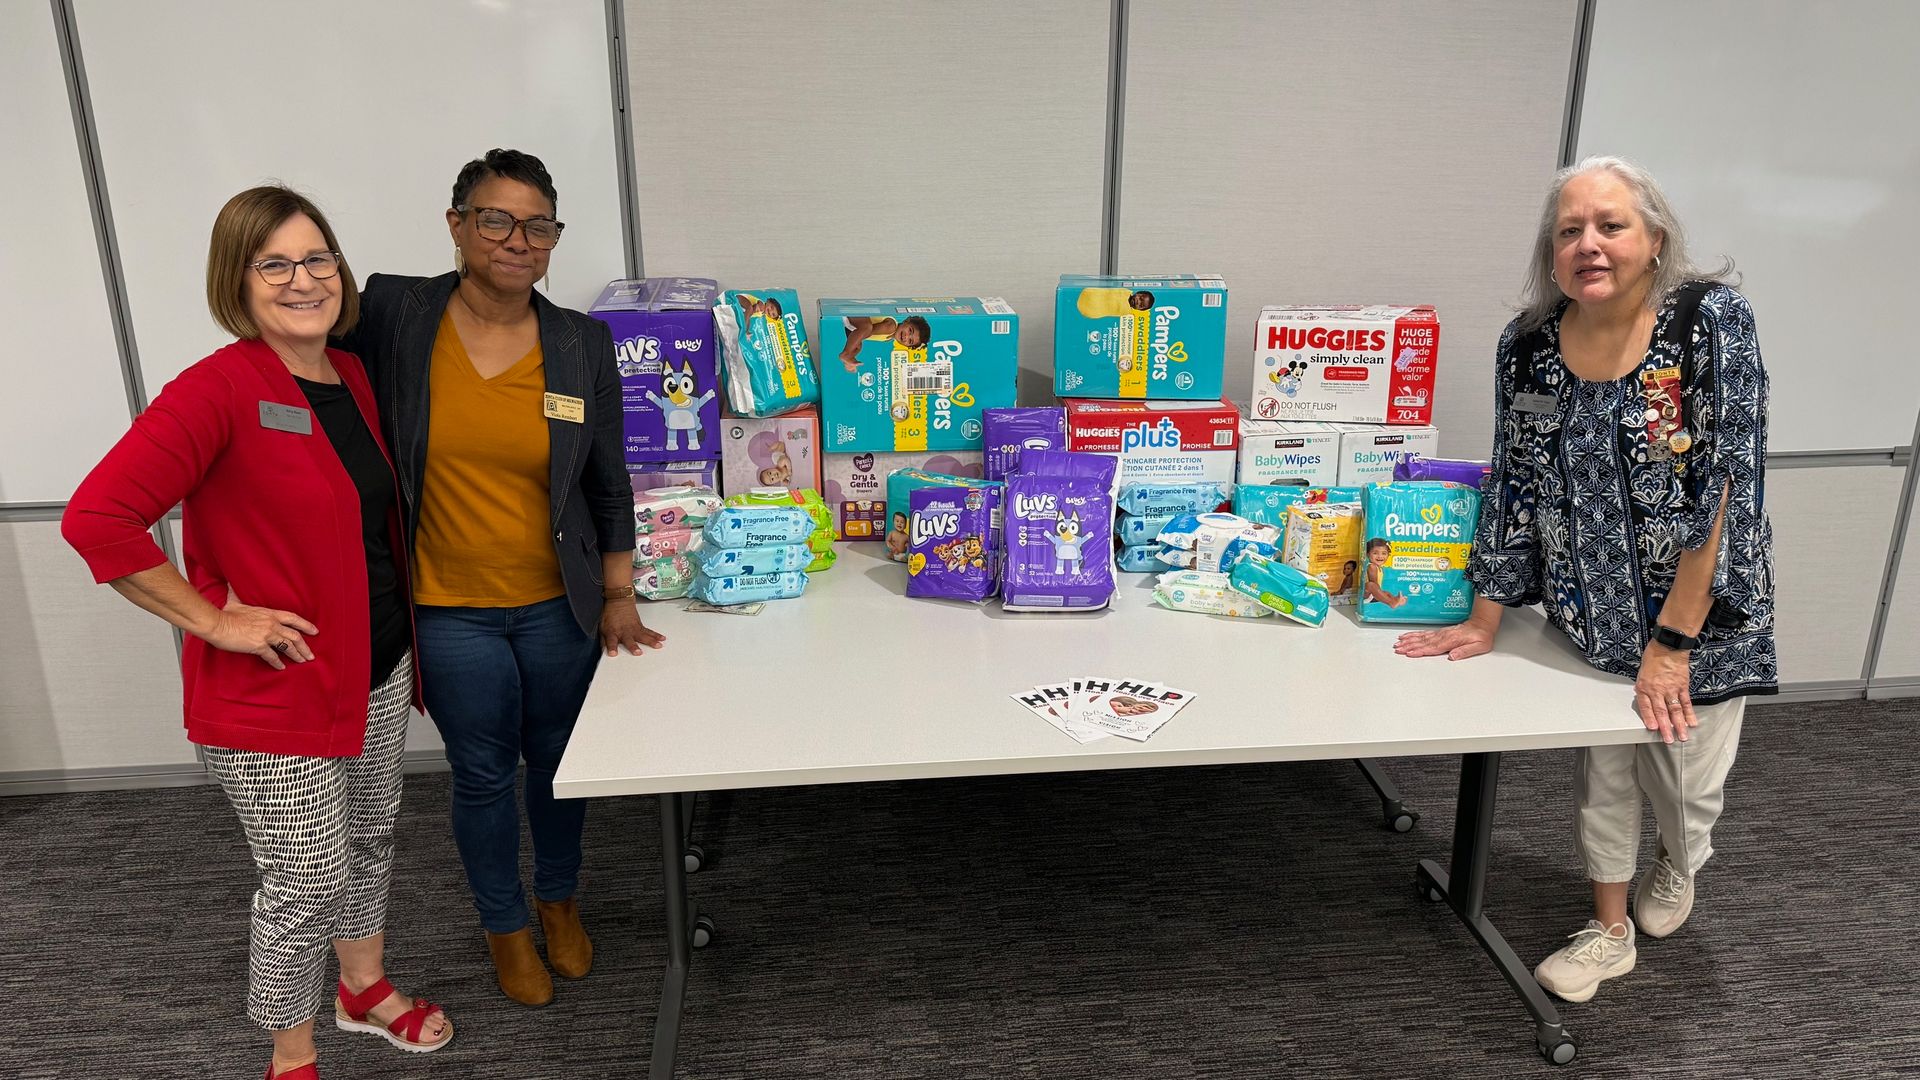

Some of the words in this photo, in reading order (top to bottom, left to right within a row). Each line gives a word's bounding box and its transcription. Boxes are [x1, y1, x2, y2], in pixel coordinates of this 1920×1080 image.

[1401, 328, 1433, 338] HUGE
[1136, 316, 1147, 372] swaddlers
[1149, 305, 1181, 381] Pampers
[1267, 326, 1386, 352] HUGGIES
[1398, 337, 1433, 347] VALUE
[777, 322, 793, 371] swaddlers
[784, 312, 808, 377] Pampers
[614, 337, 659, 367] uvs
[893, 353, 901, 366] skin
[1310, 353, 1350, 368] simply
[1352, 354, 1384, 366] clean
[624, 366, 662, 376] protection
[1076, 375, 1083, 385] 96
[1401, 372, 1424, 381] valor
[890, 367, 901, 400] protection
[1281, 402, 1293, 410] DO
[1295, 402, 1310, 410] NOT
[1312, 403, 1337, 412] FLUSH
[1396, 409, 1419, 420] 704
[847, 426, 856, 441] 136
[908, 426, 920, 438] 3
[1075, 427, 1120, 438] HUGGIES
[625, 446, 640, 454] 140
[1254, 453, 1321, 468] BabyWipes
[1144, 463, 1176, 472] CUTANÉE
[851, 474, 868, 482] Dry
[869, 474, 876, 482] &
[849, 481, 879, 489] Gentle
[1144, 504, 1187, 513] Fragrance
[743, 517, 775, 526] Fragrance
[1385, 512, 1461, 541] Pampers
[859, 523, 867, 535] 1
[746, 532, 787, 542] Fragrance
[1394, 545, 1450, 554] swaddlers
[1460, 549, 1468, 558] 3
[1019, 563, 1026, 571] 3
[754, 576, 767, 585] FLUSH
[1238, 580, 1261, 597] Pampers
[1190, 599, 1207, 607] baby
[1116, 681, 1184, 701] HLP
[1105, 713, 1133, 723] MISSION
[1098, 721, 1122, 731] VISION
